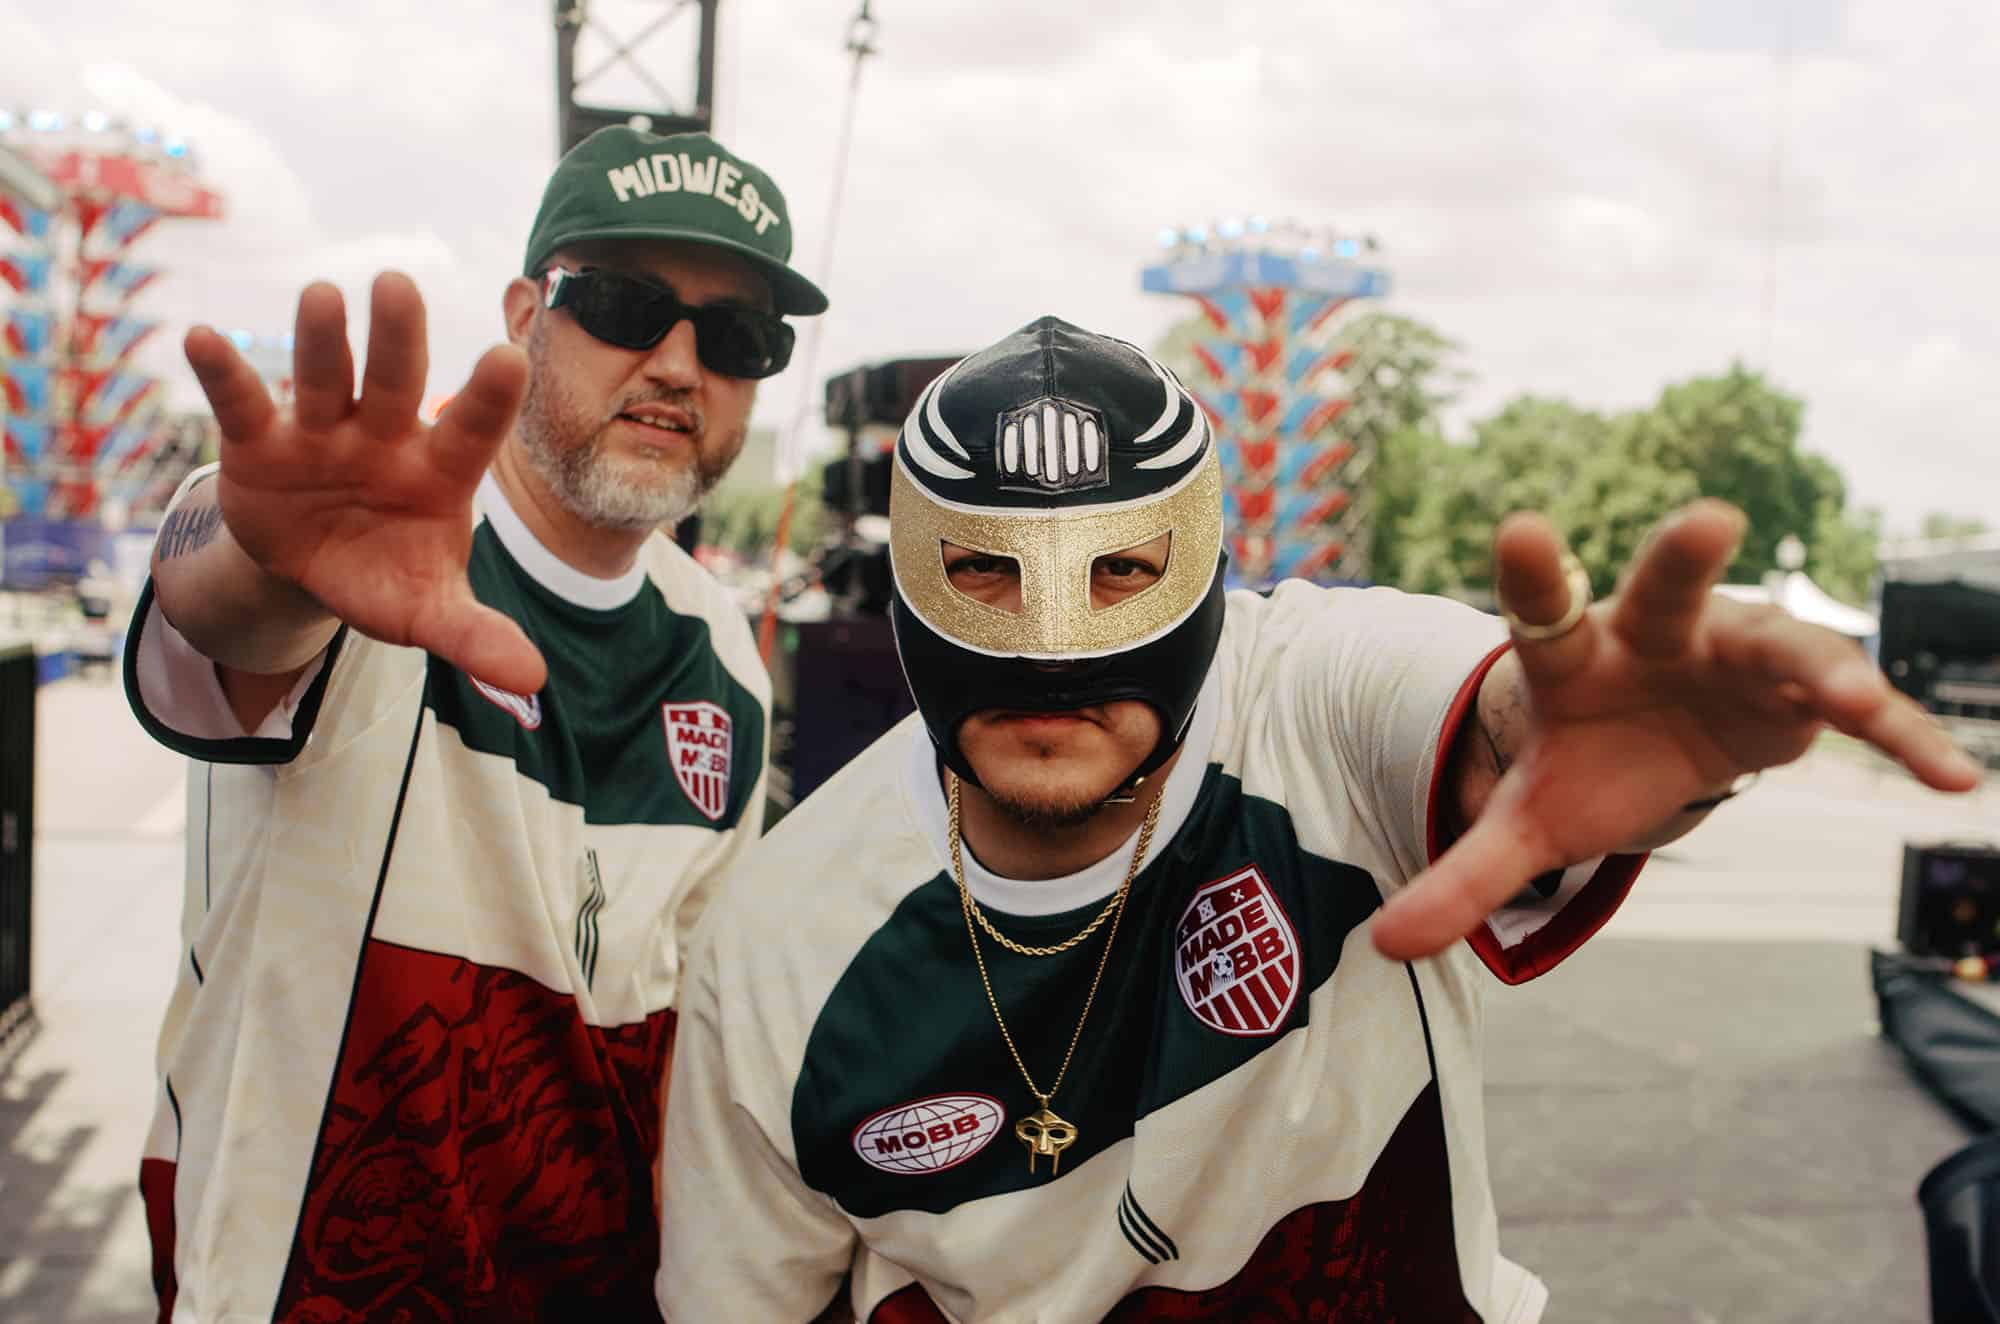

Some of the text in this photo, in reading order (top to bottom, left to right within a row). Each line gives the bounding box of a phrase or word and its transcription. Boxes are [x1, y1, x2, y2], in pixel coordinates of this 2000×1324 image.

[607, 153, 780, 236] MIDWEST
[1179, 900, 1269, 974] MADE
[874, 1113, 981, 1155] MOBB
